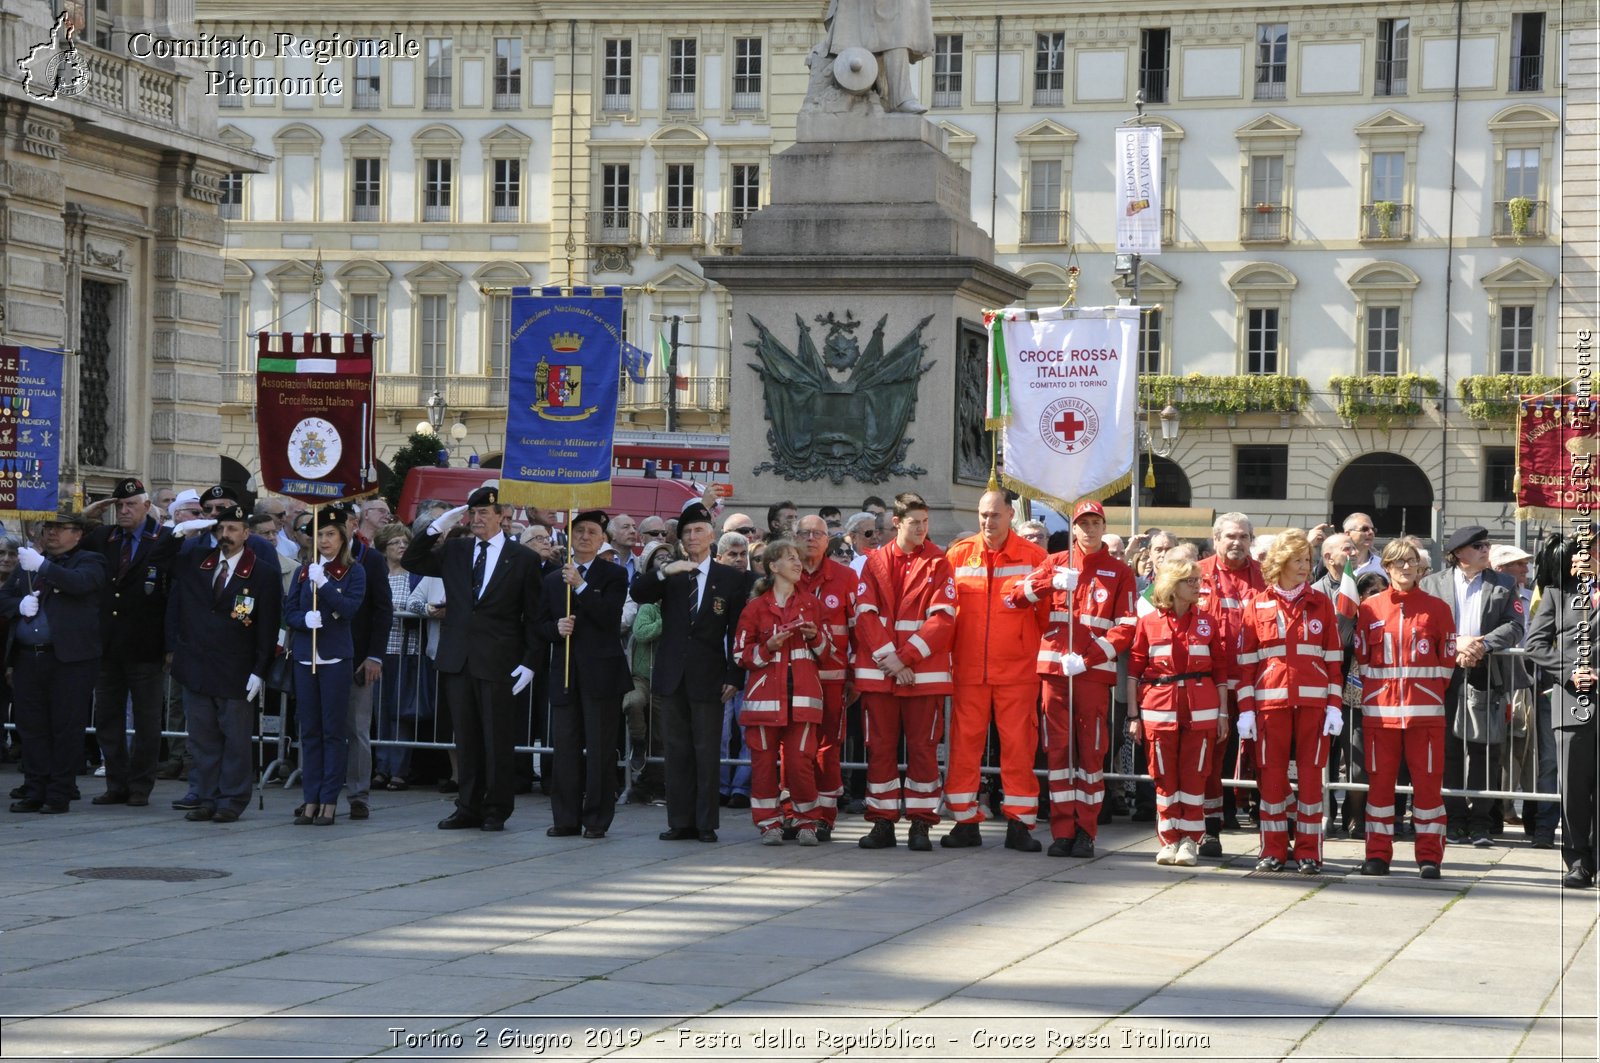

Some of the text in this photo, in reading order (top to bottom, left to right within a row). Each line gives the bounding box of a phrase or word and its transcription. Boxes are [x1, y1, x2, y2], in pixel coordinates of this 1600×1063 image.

[1126, 133, 1136, 198] LEONARDO
[1141, 145, 1150, 178] VINCI
[1141, 182, 1150, 198] DA
[511, 308, 552, 343] Associazione
[554, 304, 594, 317] Nazionale
[1019, 349, 1118, 362] CROCE ROSSA
[1037, 365, 1098, 378] ITALIANA
[4, 376, 46, 385] NAZIONALE
[307, 378, 345, 390] Nazionale
[346, 378, 371, 391] Militari
[1030, 381, 1067, 389] COMITATO
[28, 389, 57, 397] D'ITALIA
[279, 393, 354, 407] Croce Rossa Italiana
[1057, 399, 1084, 410] GINEVRA
[1049, 404, 1058, 413] DI
[11, 417, 51, 426] BANDIERA
[1087, 415, 1097, 436] AGOSTO
[1042, 411, 1060, 448] CONVENZIONE
[520, 437, 561, 447] Accademia
[563, 438, 598, 447] Militare
[548, 449, 578, 458] Modena
[520, 466, 600, 478] Sezione Piemonte
[1528, 474, 1565, 485] SEZIONE
